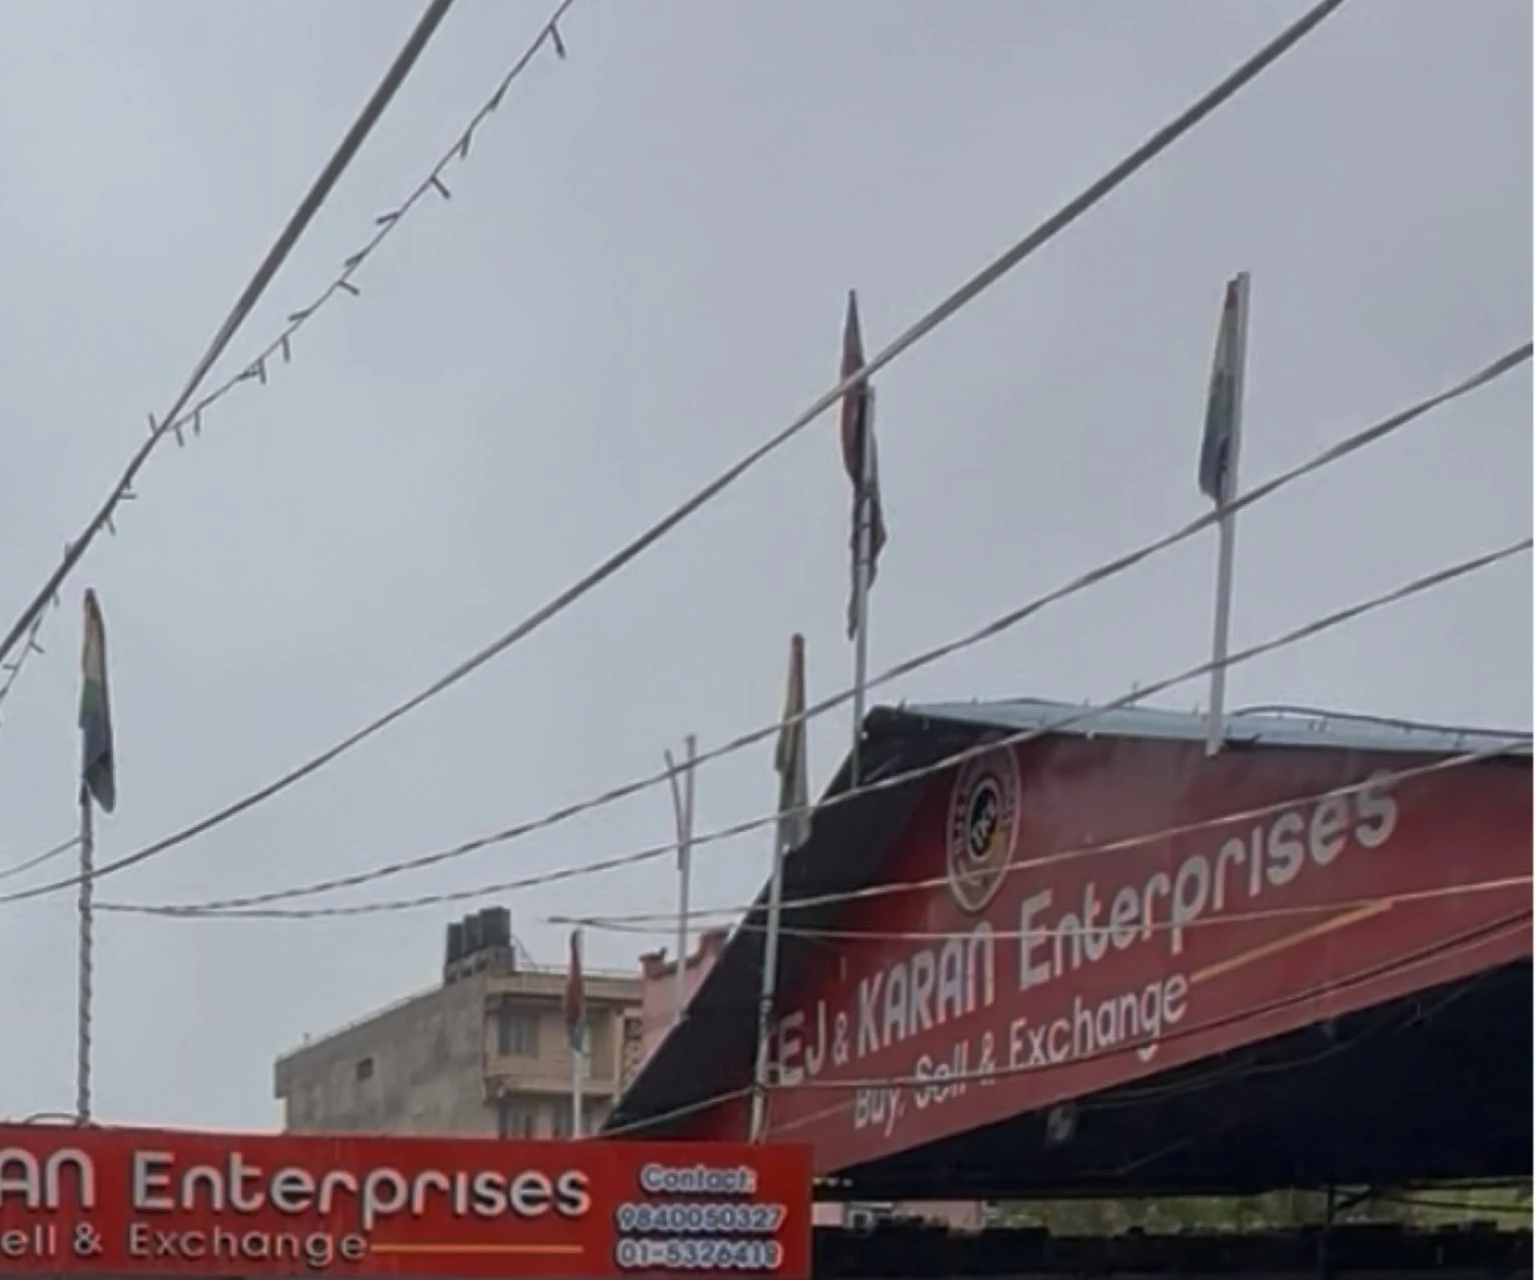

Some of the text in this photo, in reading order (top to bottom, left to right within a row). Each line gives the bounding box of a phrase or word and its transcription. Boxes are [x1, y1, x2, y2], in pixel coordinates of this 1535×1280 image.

[762, 1000, 826, 1086] EJ
[833, 1012, 849, 1066] &
[857, 921, 994, 1057] KARAN
[1019, 768, 1397, 991] Enterprises
[914, 1039, 969, 1108] Sell
[978, 1032, 996, 1086] &
[1009, 973, 1188, 1069] Exchange
[133, 1150, 592, 1230] Enterprises
[73, 1223, 104, 1257] &
[129, 1223, 367, 1267] Exchange
